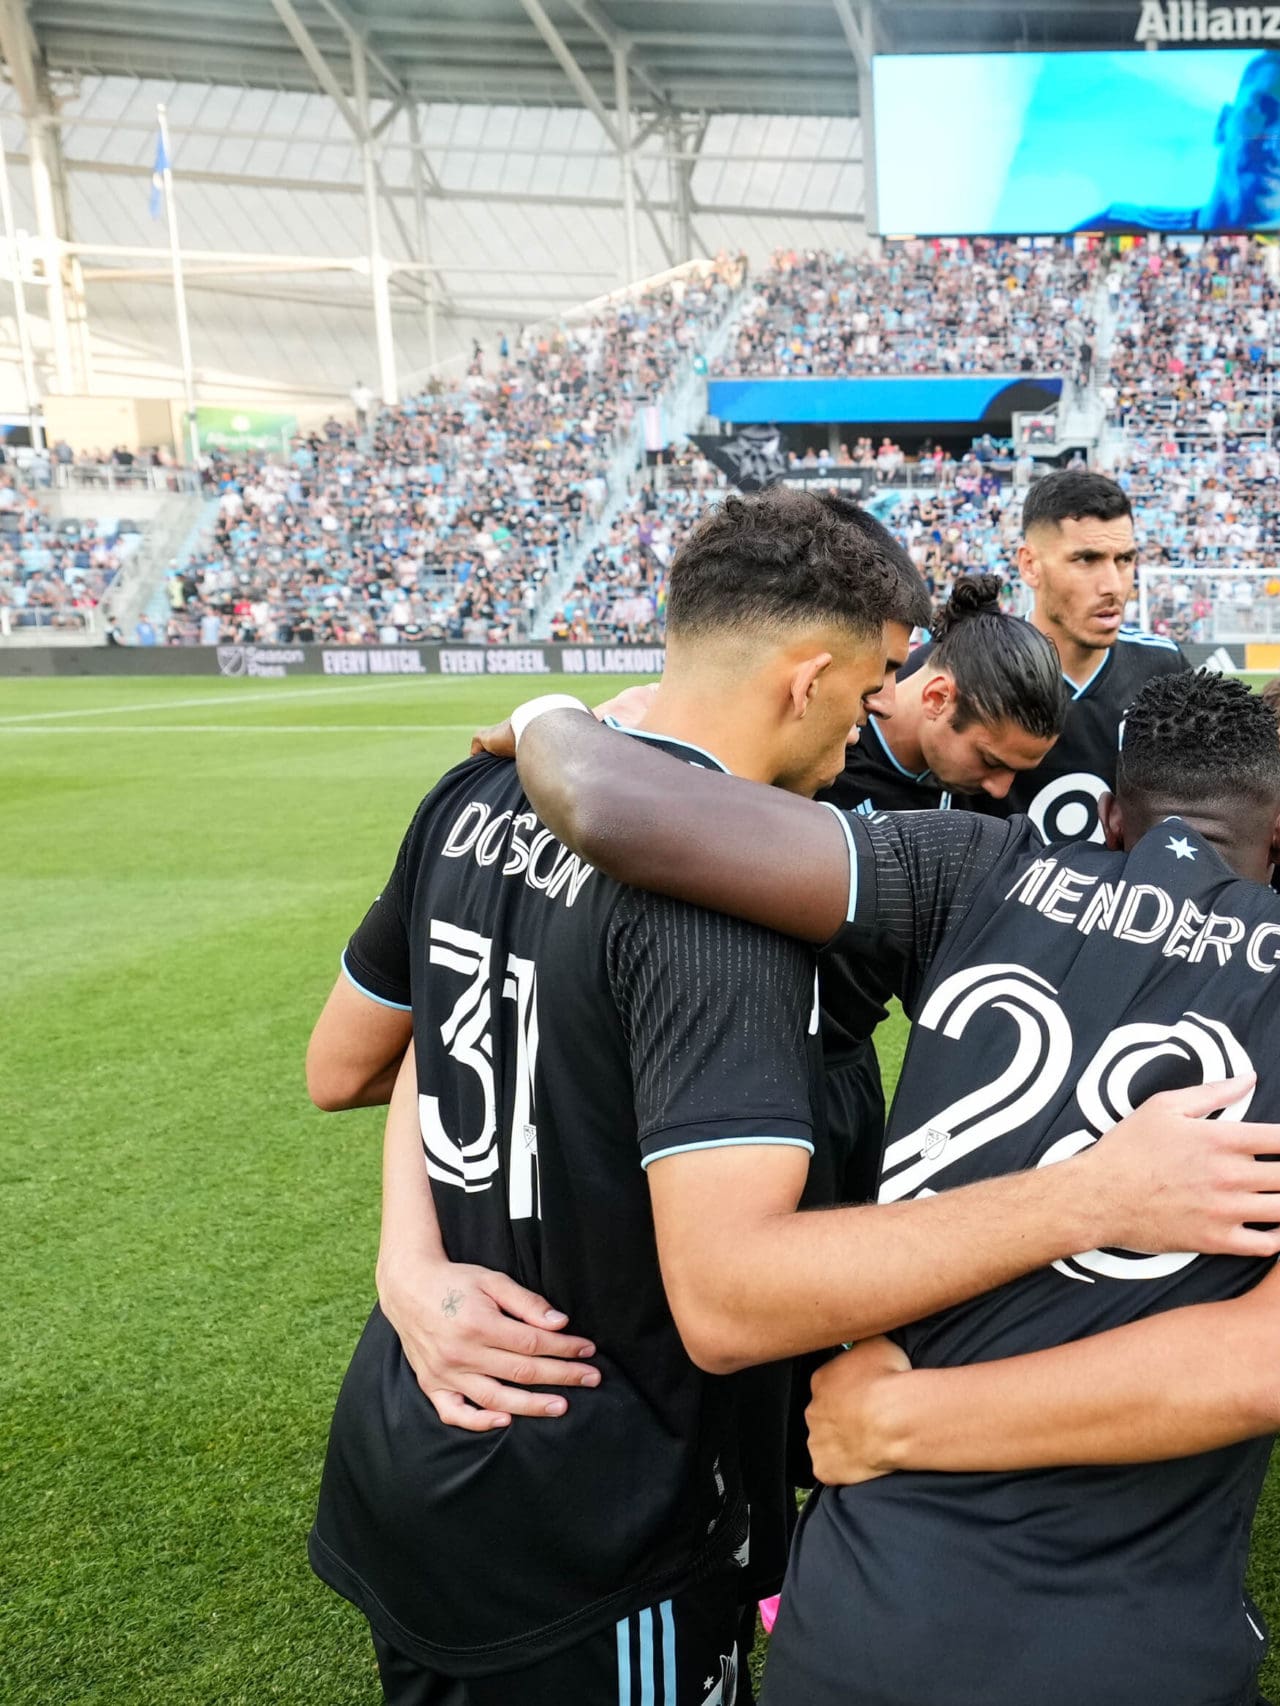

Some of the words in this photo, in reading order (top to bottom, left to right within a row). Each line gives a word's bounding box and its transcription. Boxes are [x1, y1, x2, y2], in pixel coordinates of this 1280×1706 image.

[322, 649, 367, 674] EVERY
[369, 649, 427, 674] MATCH.
[439, 649, 484, 674] EVERY
[486, 649, 551, 674] SCREEN.
[562, 648, 585, 673] NO
[418, 918, 543, 1221] 31
[877, 962, 1258, 1284] 28
